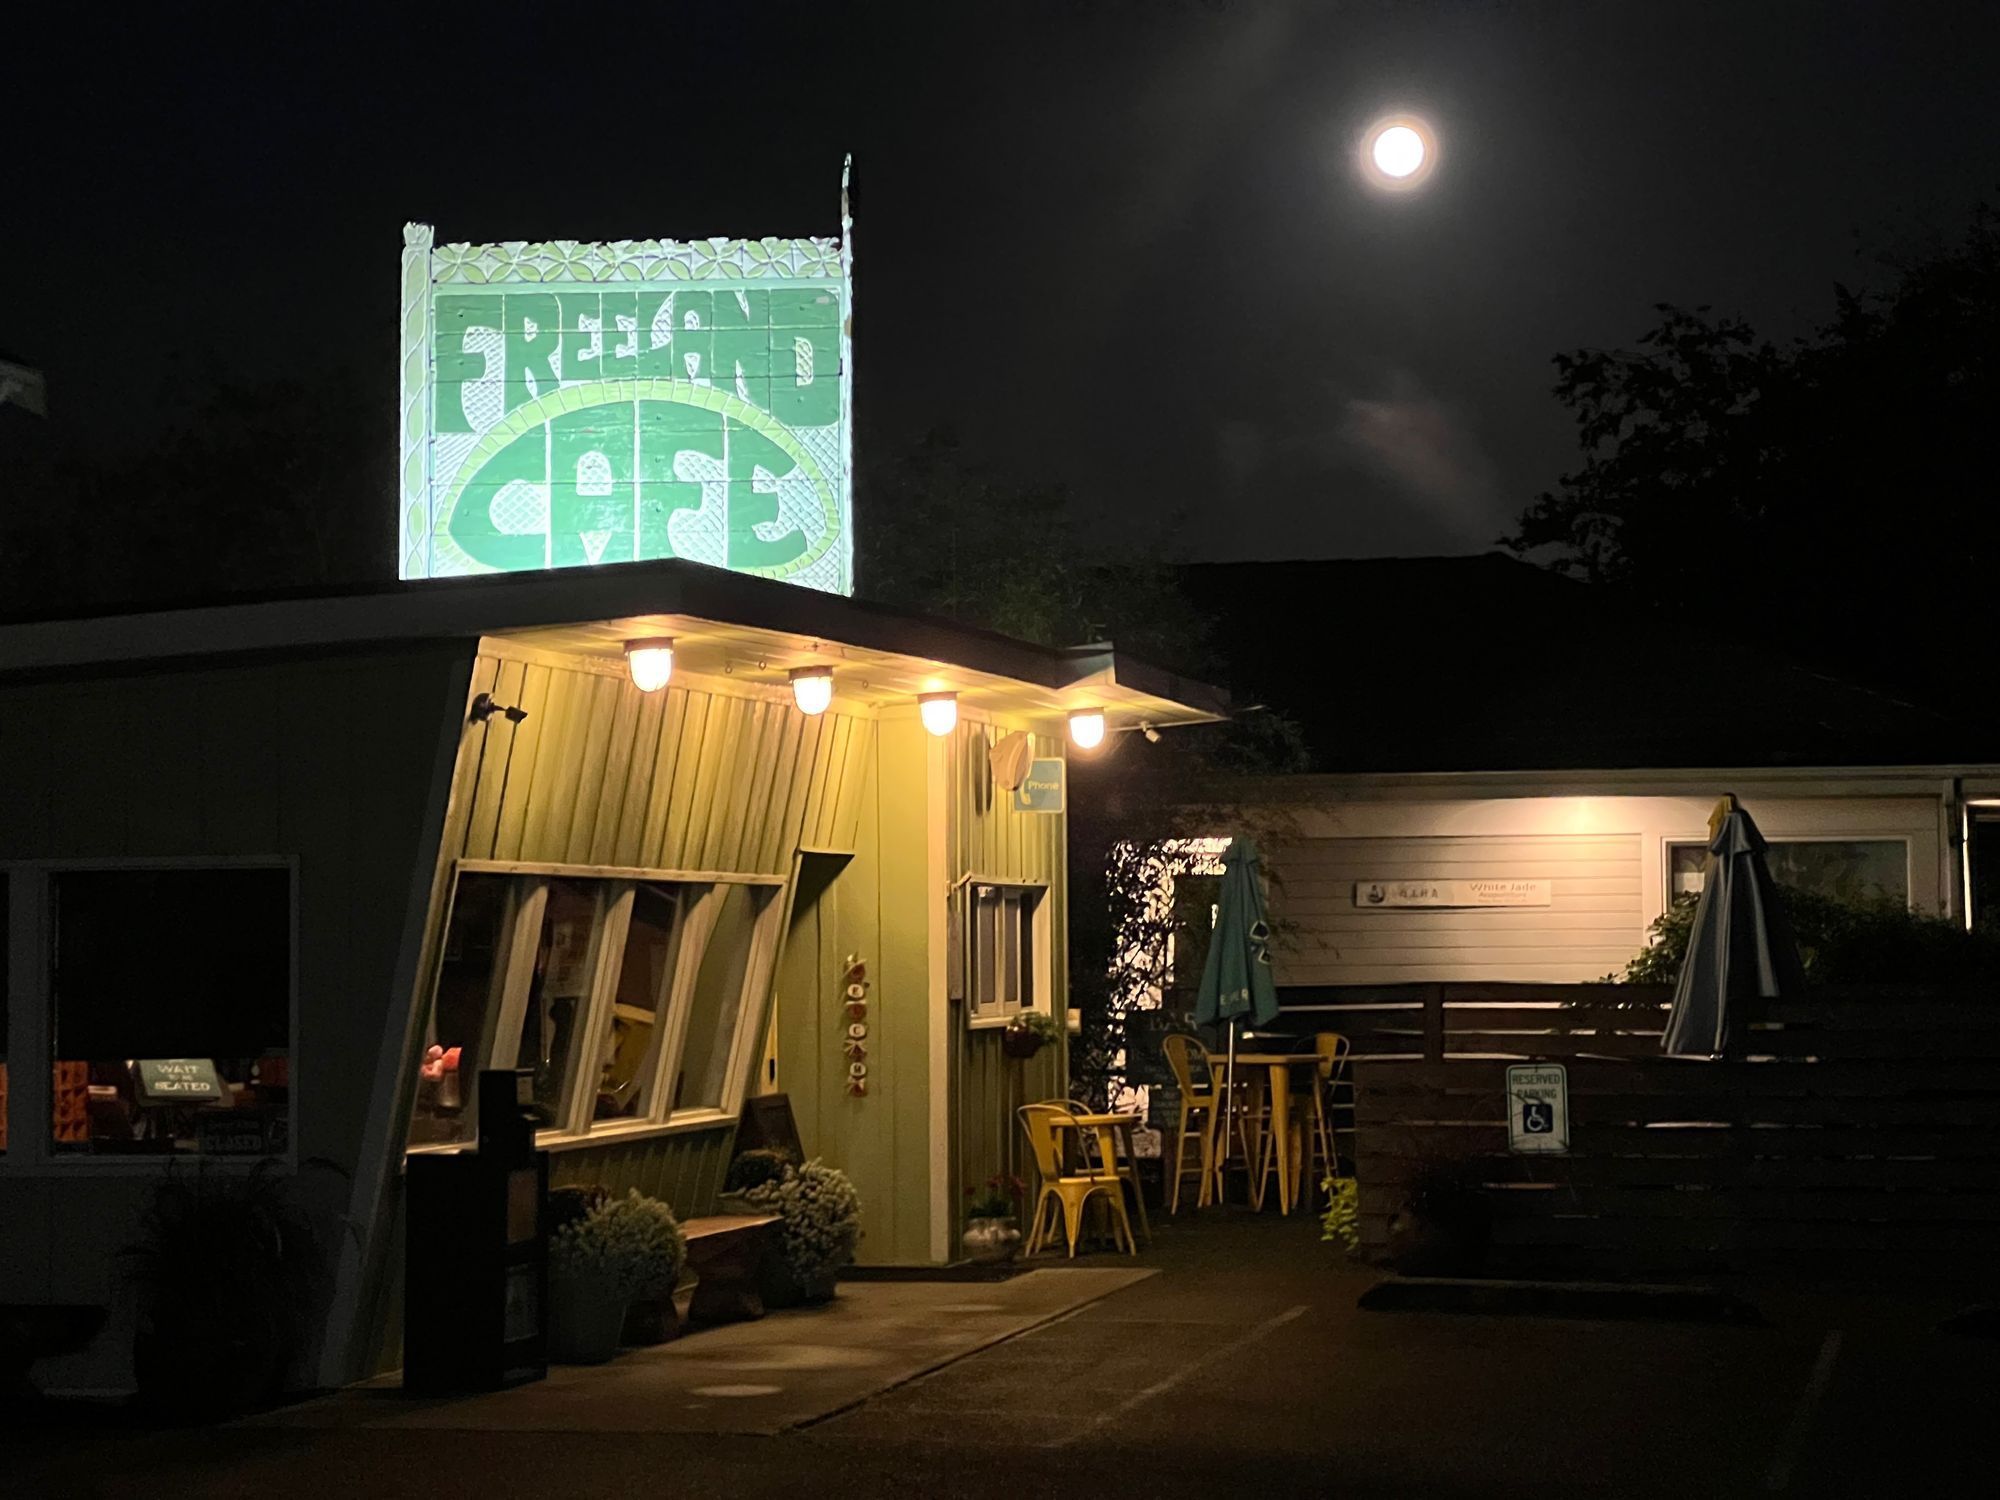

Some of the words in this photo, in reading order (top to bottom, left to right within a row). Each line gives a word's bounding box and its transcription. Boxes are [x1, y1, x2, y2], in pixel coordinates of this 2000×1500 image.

[434, 289, 840, 433] FREELAND
[447, 399, 808, 571] CAFE
[1470, 882, 1506, 892] White
[1511, 882, 1536, 892] Jade
[157, 1064, 199, 1074] WAIT
[1512, 1074, 1560, 1085] RESERVED
[154, 1081, 211, 1092] SEATED
[1516, 1088, 1557, 1099] PARKING
